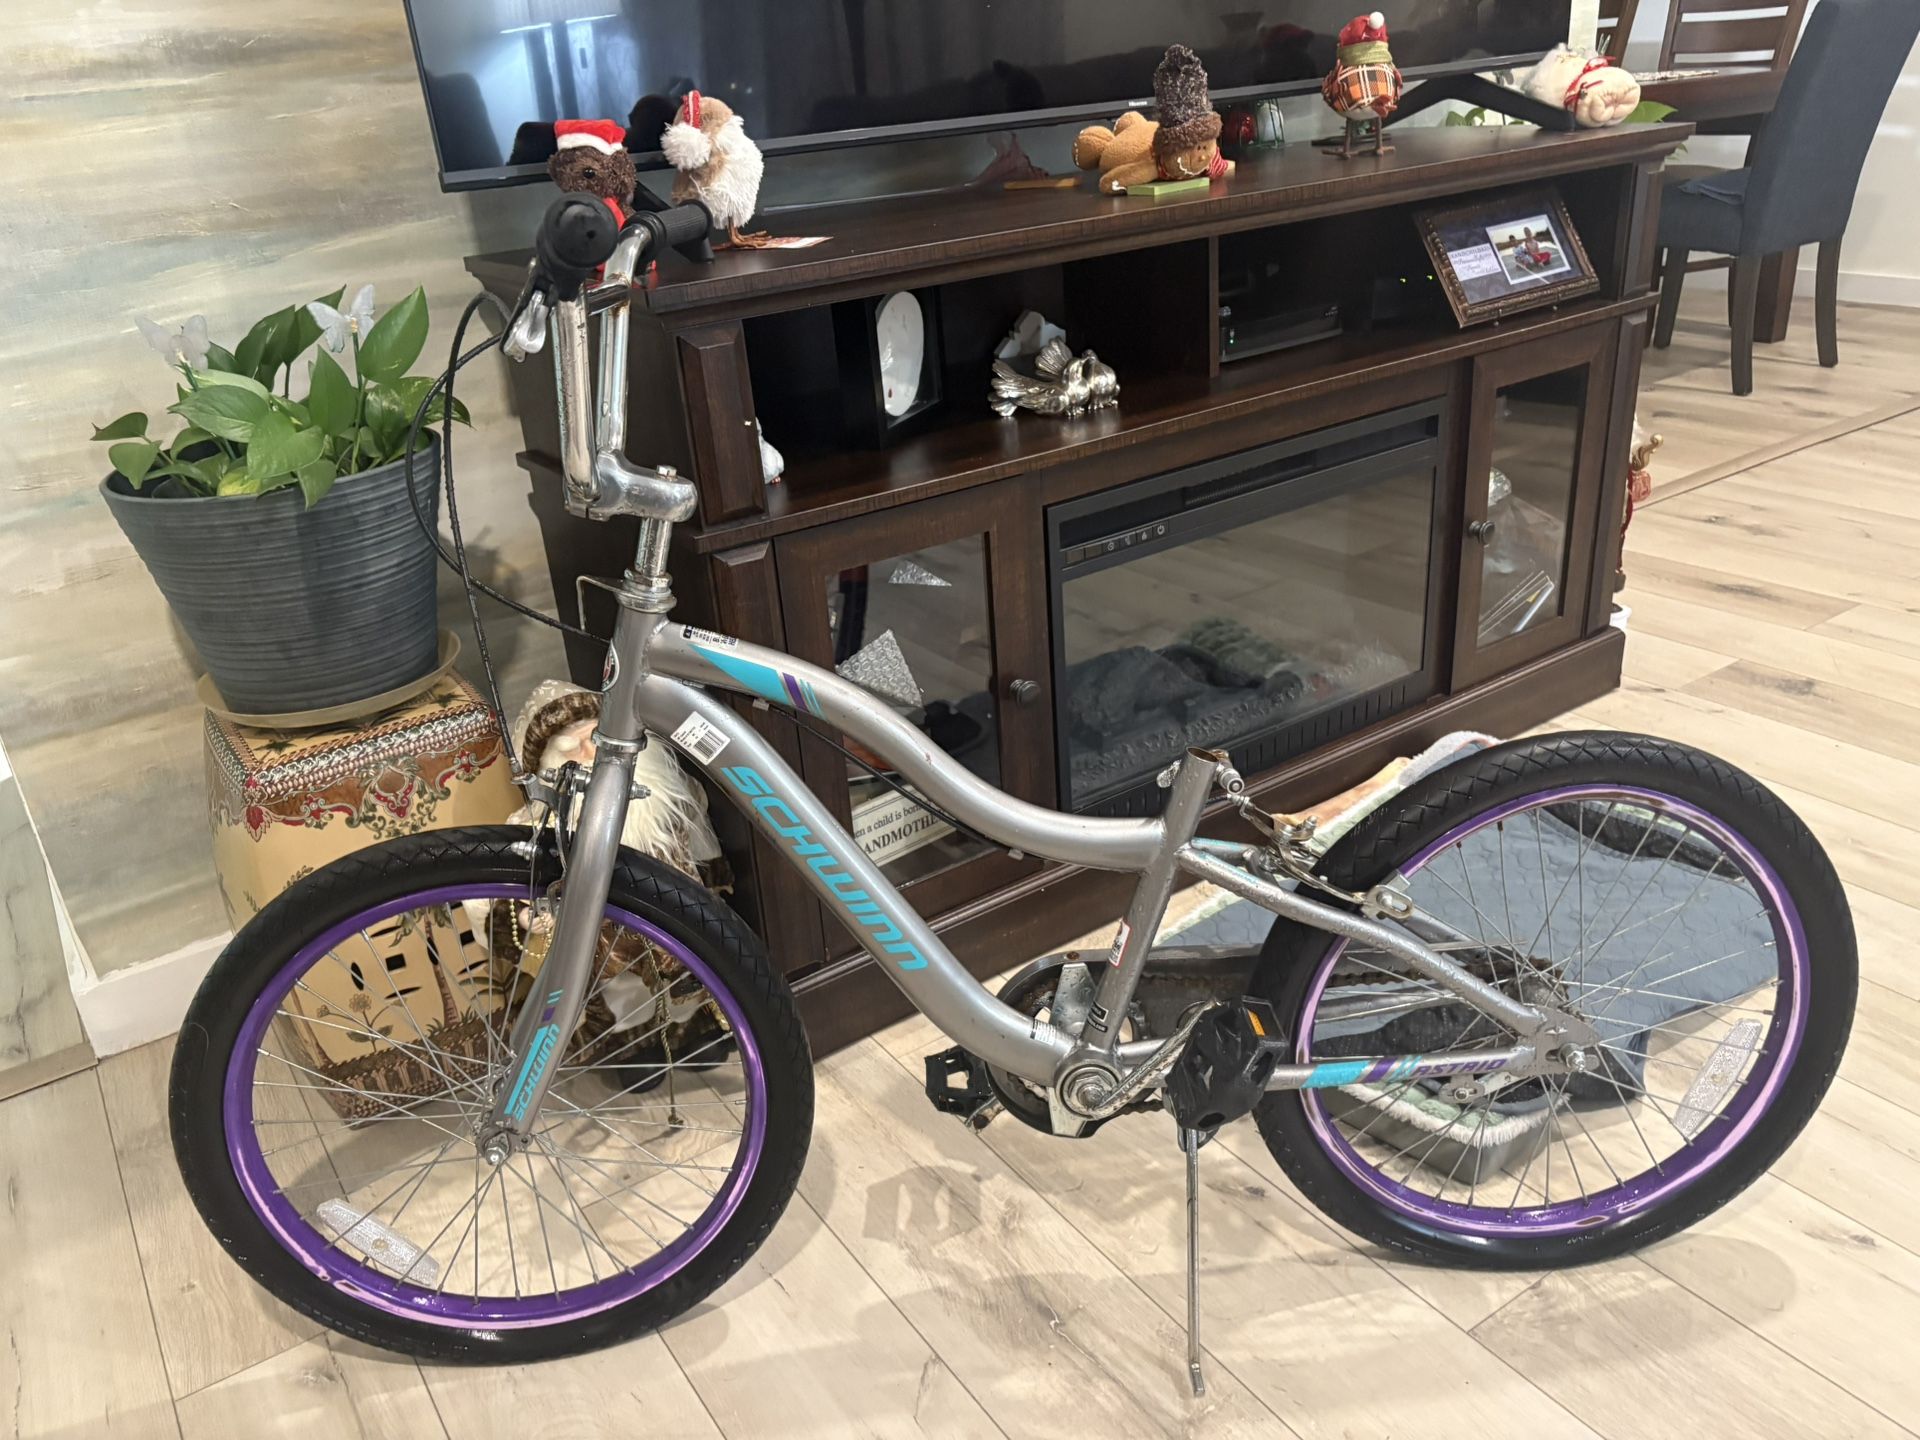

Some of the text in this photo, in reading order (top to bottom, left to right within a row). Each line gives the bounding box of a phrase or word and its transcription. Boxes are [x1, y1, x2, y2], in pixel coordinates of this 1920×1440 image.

[863, 812, 939, 855] ANDMOTHE
[873, 812, 894, 830] child
[895, 810, 902, 821] is
[720, 766, 929, 971] SCHWINN
[513, 1023, 560, 1121] SCHWINN
[1410, 1058, 1507, 1077] ASTRID
